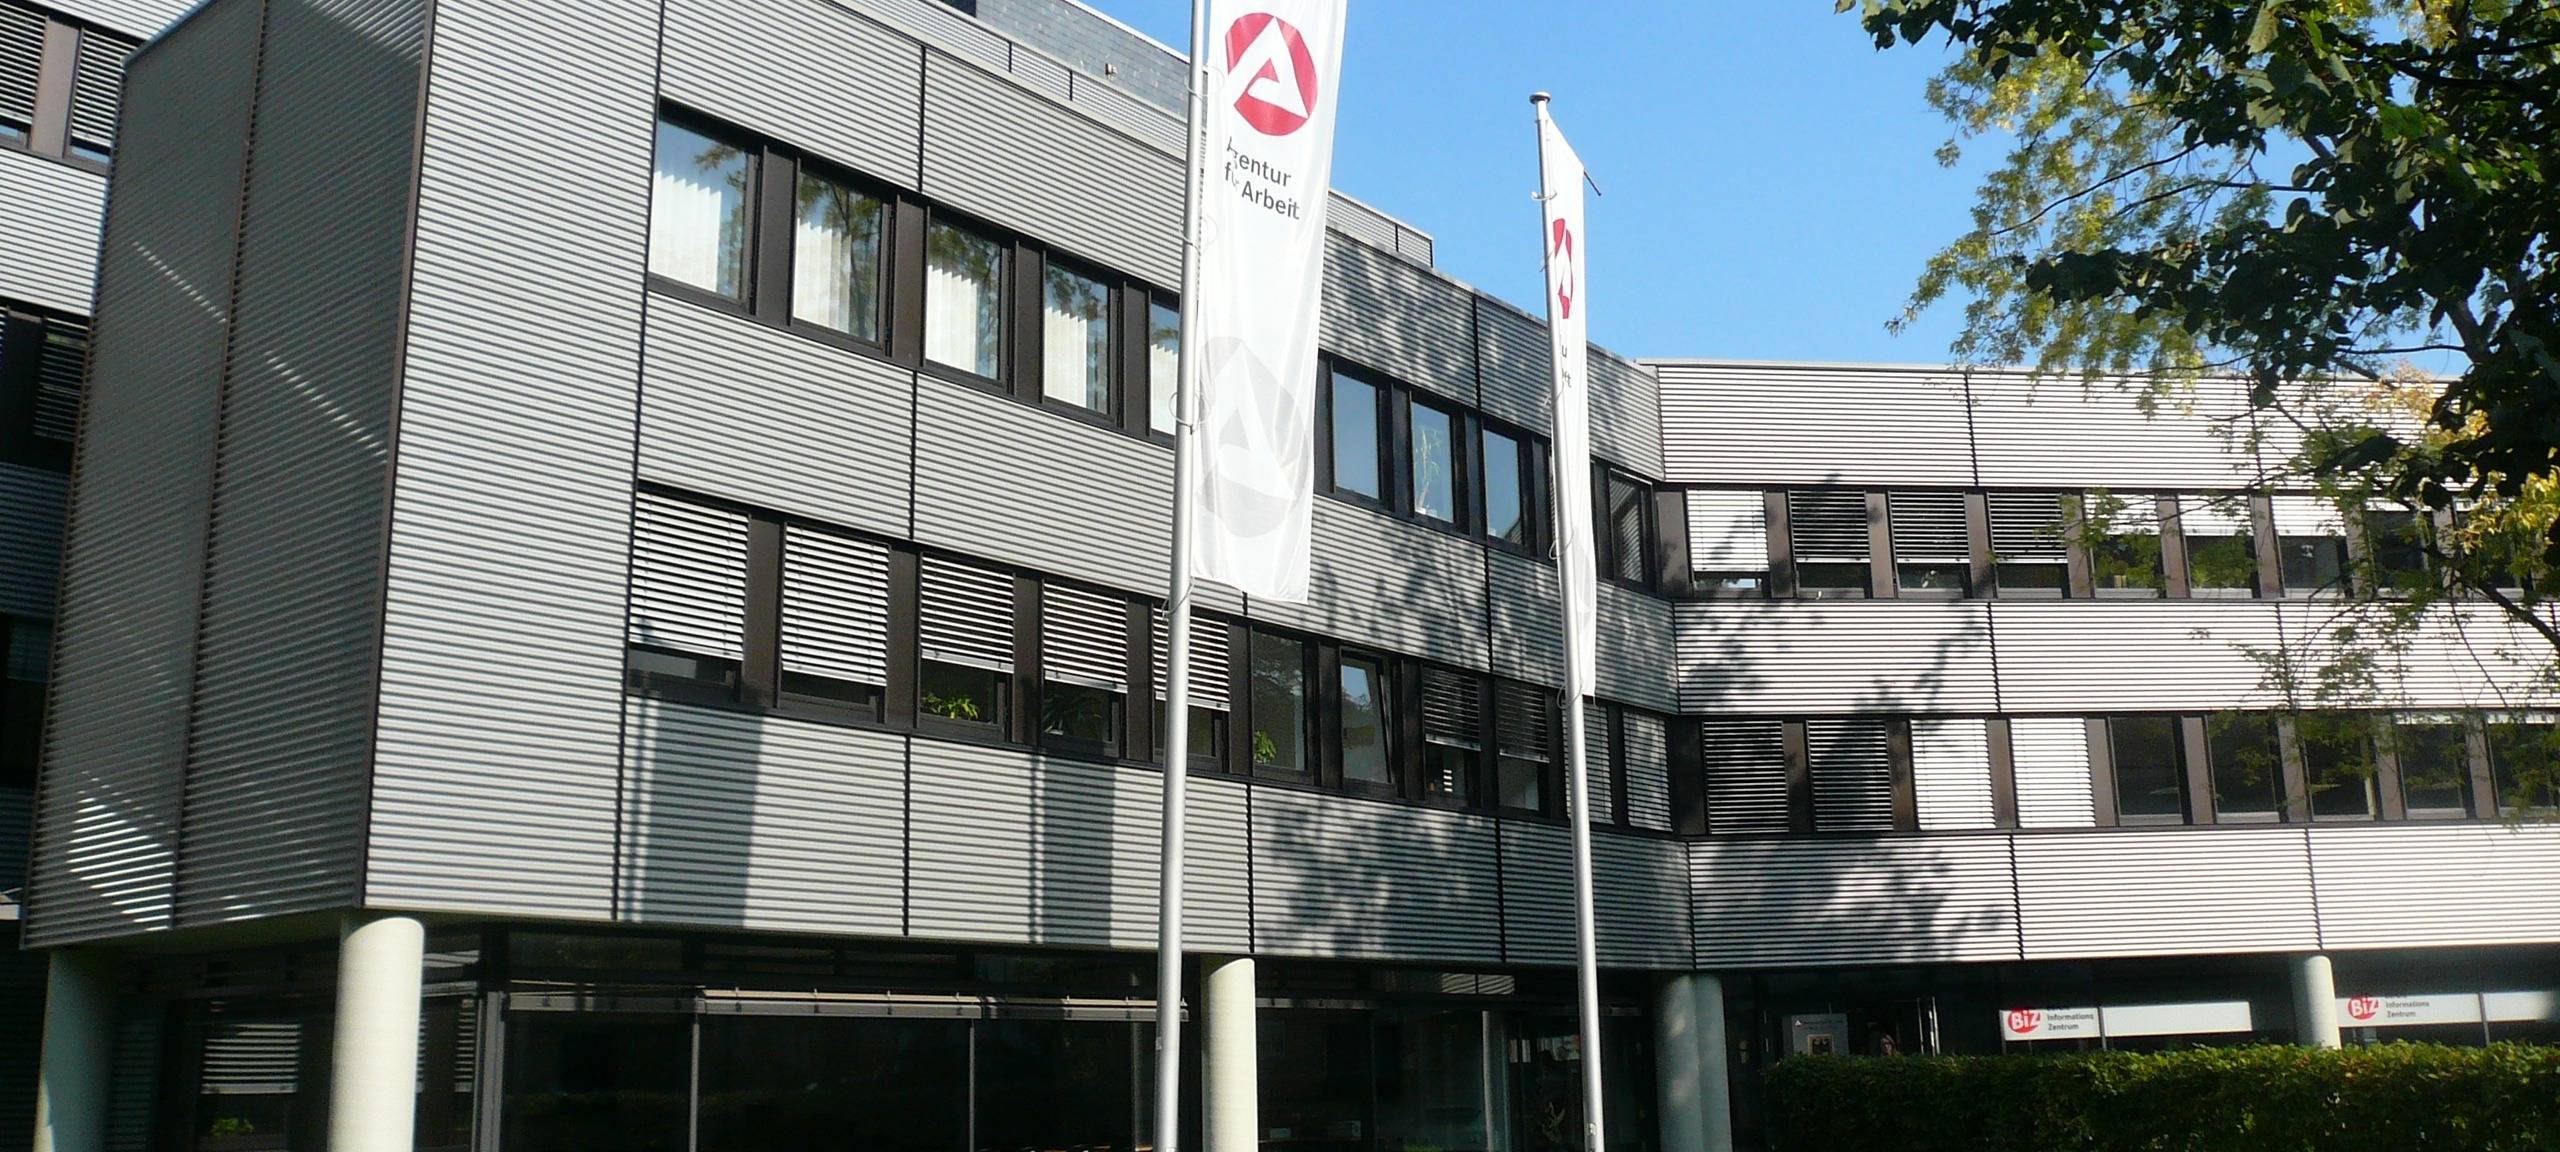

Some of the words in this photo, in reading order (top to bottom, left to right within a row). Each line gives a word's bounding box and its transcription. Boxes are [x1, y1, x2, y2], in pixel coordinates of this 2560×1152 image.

[1226, 136, 1291, 187] entur
[1241, 180, 1300, 220] Arbeit
[2047, 1012, 2094, 1021] Informations
[2048, 1023, 2080, 1031] Zentrum
